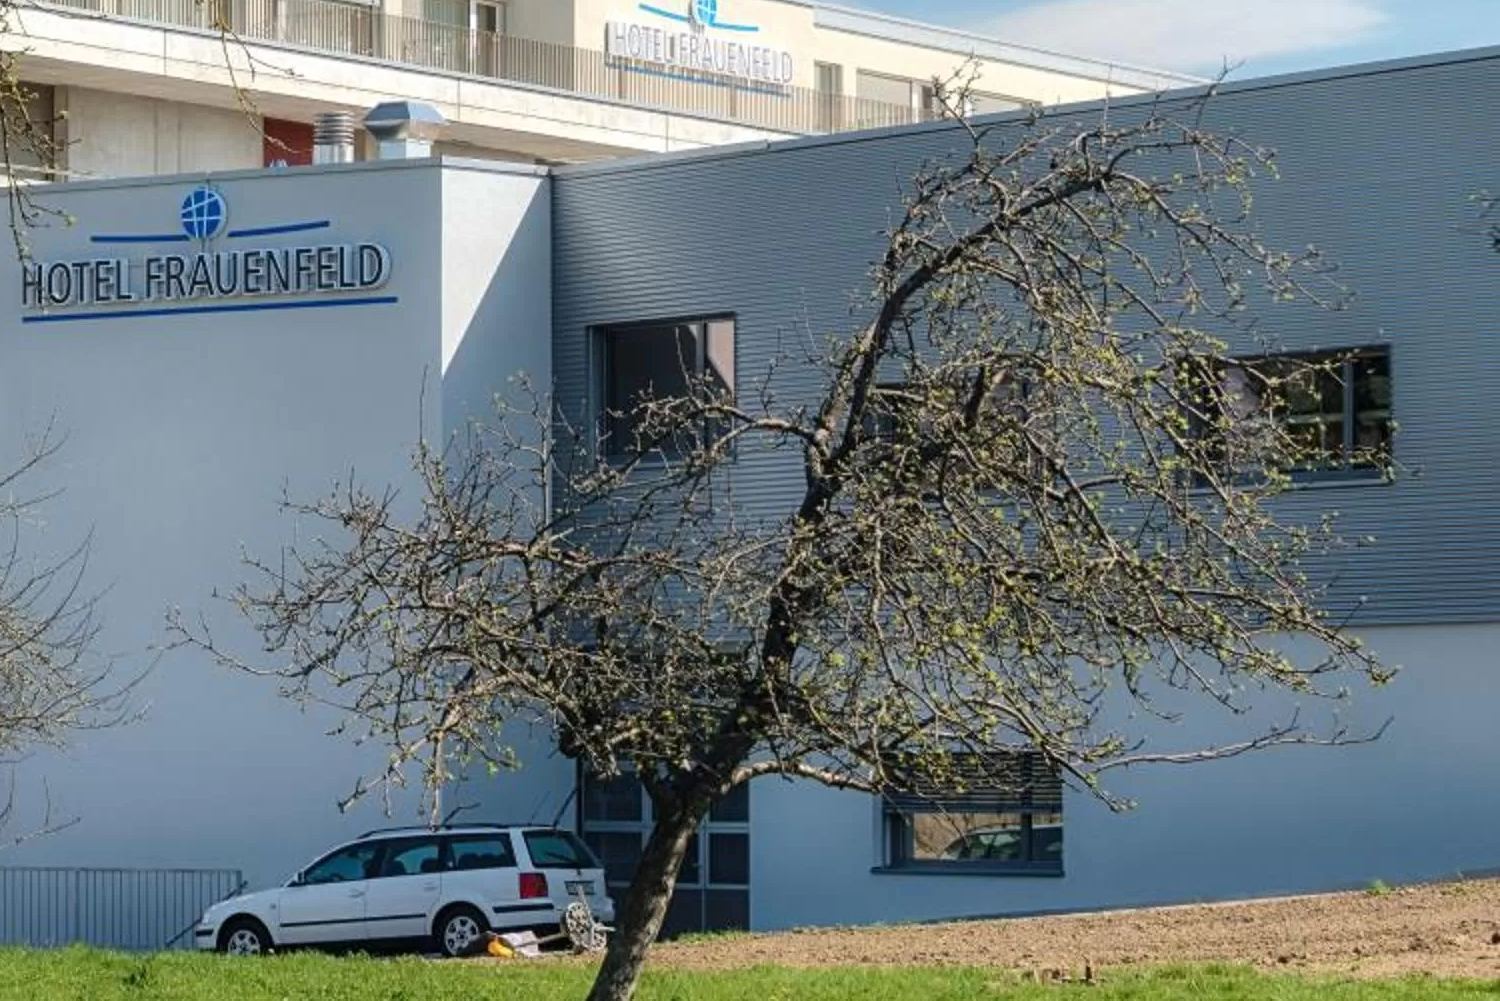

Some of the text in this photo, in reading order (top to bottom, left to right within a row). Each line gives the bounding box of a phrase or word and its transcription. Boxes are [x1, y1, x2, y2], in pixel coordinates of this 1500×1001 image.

[612, 22, 793, 84] HOTEL FRAUENFELD
[22, 243, 384, 305] HOTEL FRAUENFELD
